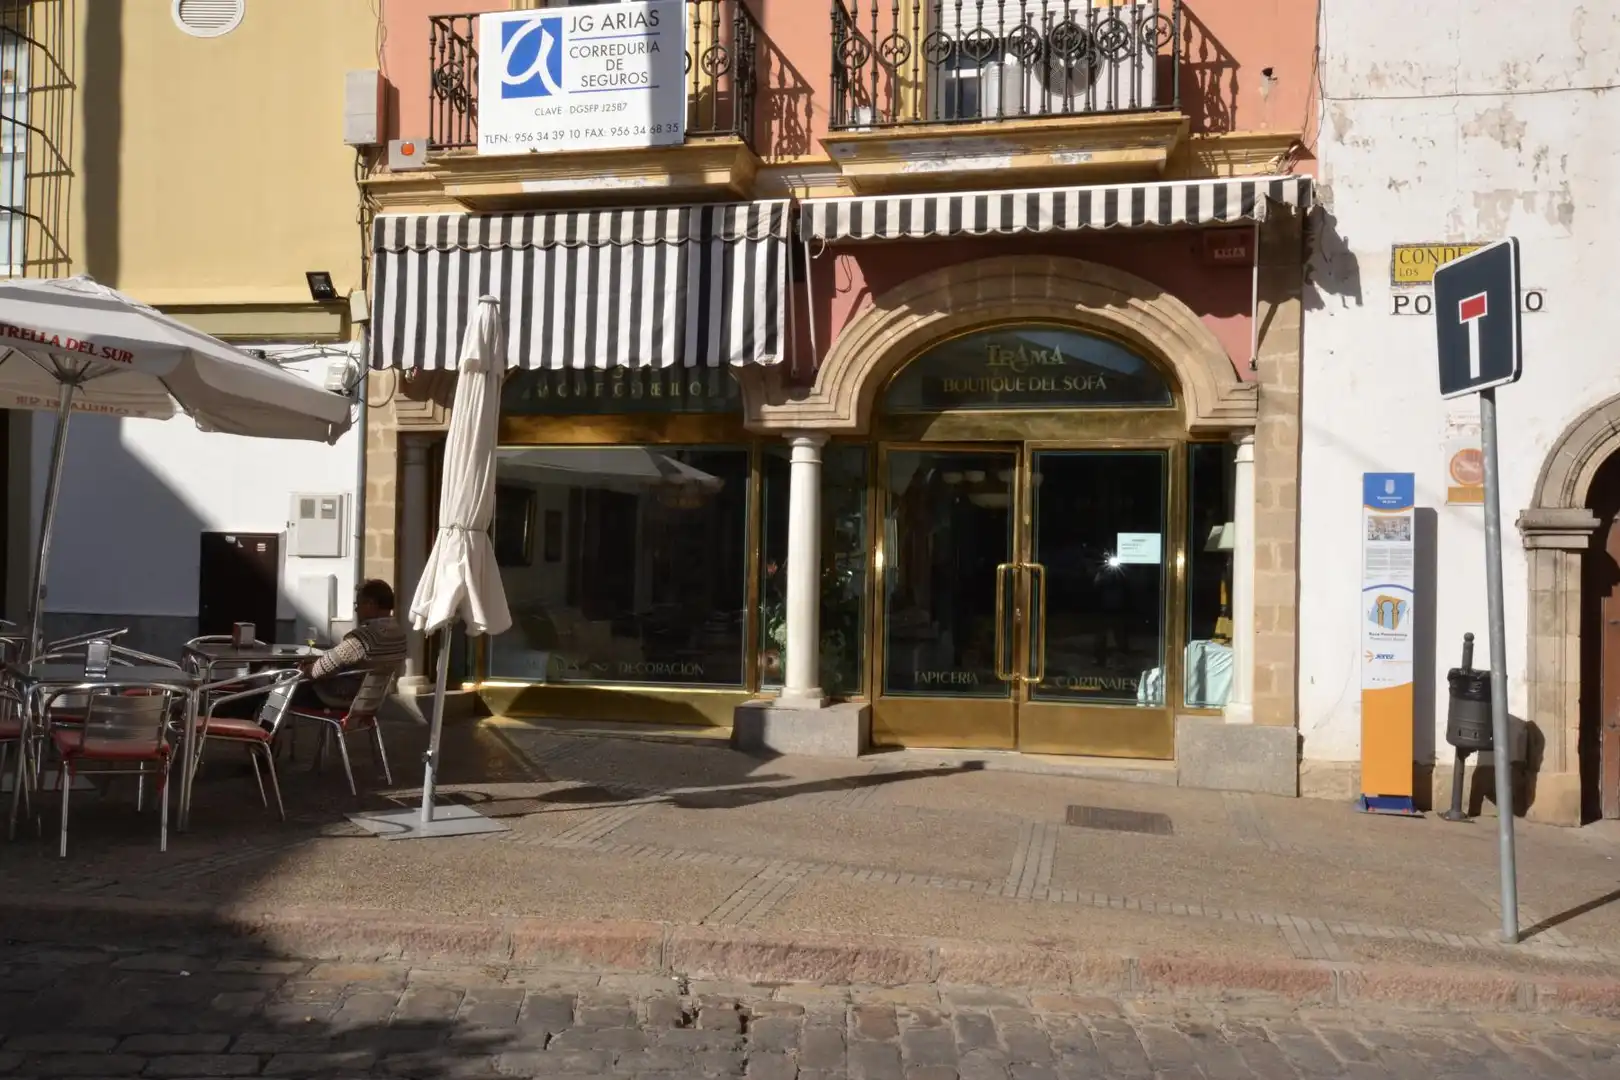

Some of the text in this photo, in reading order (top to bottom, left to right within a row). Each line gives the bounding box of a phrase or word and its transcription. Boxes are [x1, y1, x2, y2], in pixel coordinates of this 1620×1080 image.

[569, 9, 660, 33] JG ARIAS
[569, 40, 661, 59] CORREDURIA
[606, 58, 624, 71] DE
[581, 71, 648, 87] SEGUROS
[534, 102, 628, 116] CLAVE DGSFP J2587
[514, 132, 533, 143] 956
[536, 131, 549, 141] 34
[552, 130, 565, 140] 39
[569, 129, 581, 139] 10
[610, 126, 630, 137] 956
[633, 125, 646, 135] 34
[650, 124, 662, 134] 68
[666, 123, 679, 133] 35
[66, 337, 97, 356] DEL
[100, 345, 134, 364] SUR
[943, 372, 1108, 393] BOUTIQUE DEL SOFÁ
